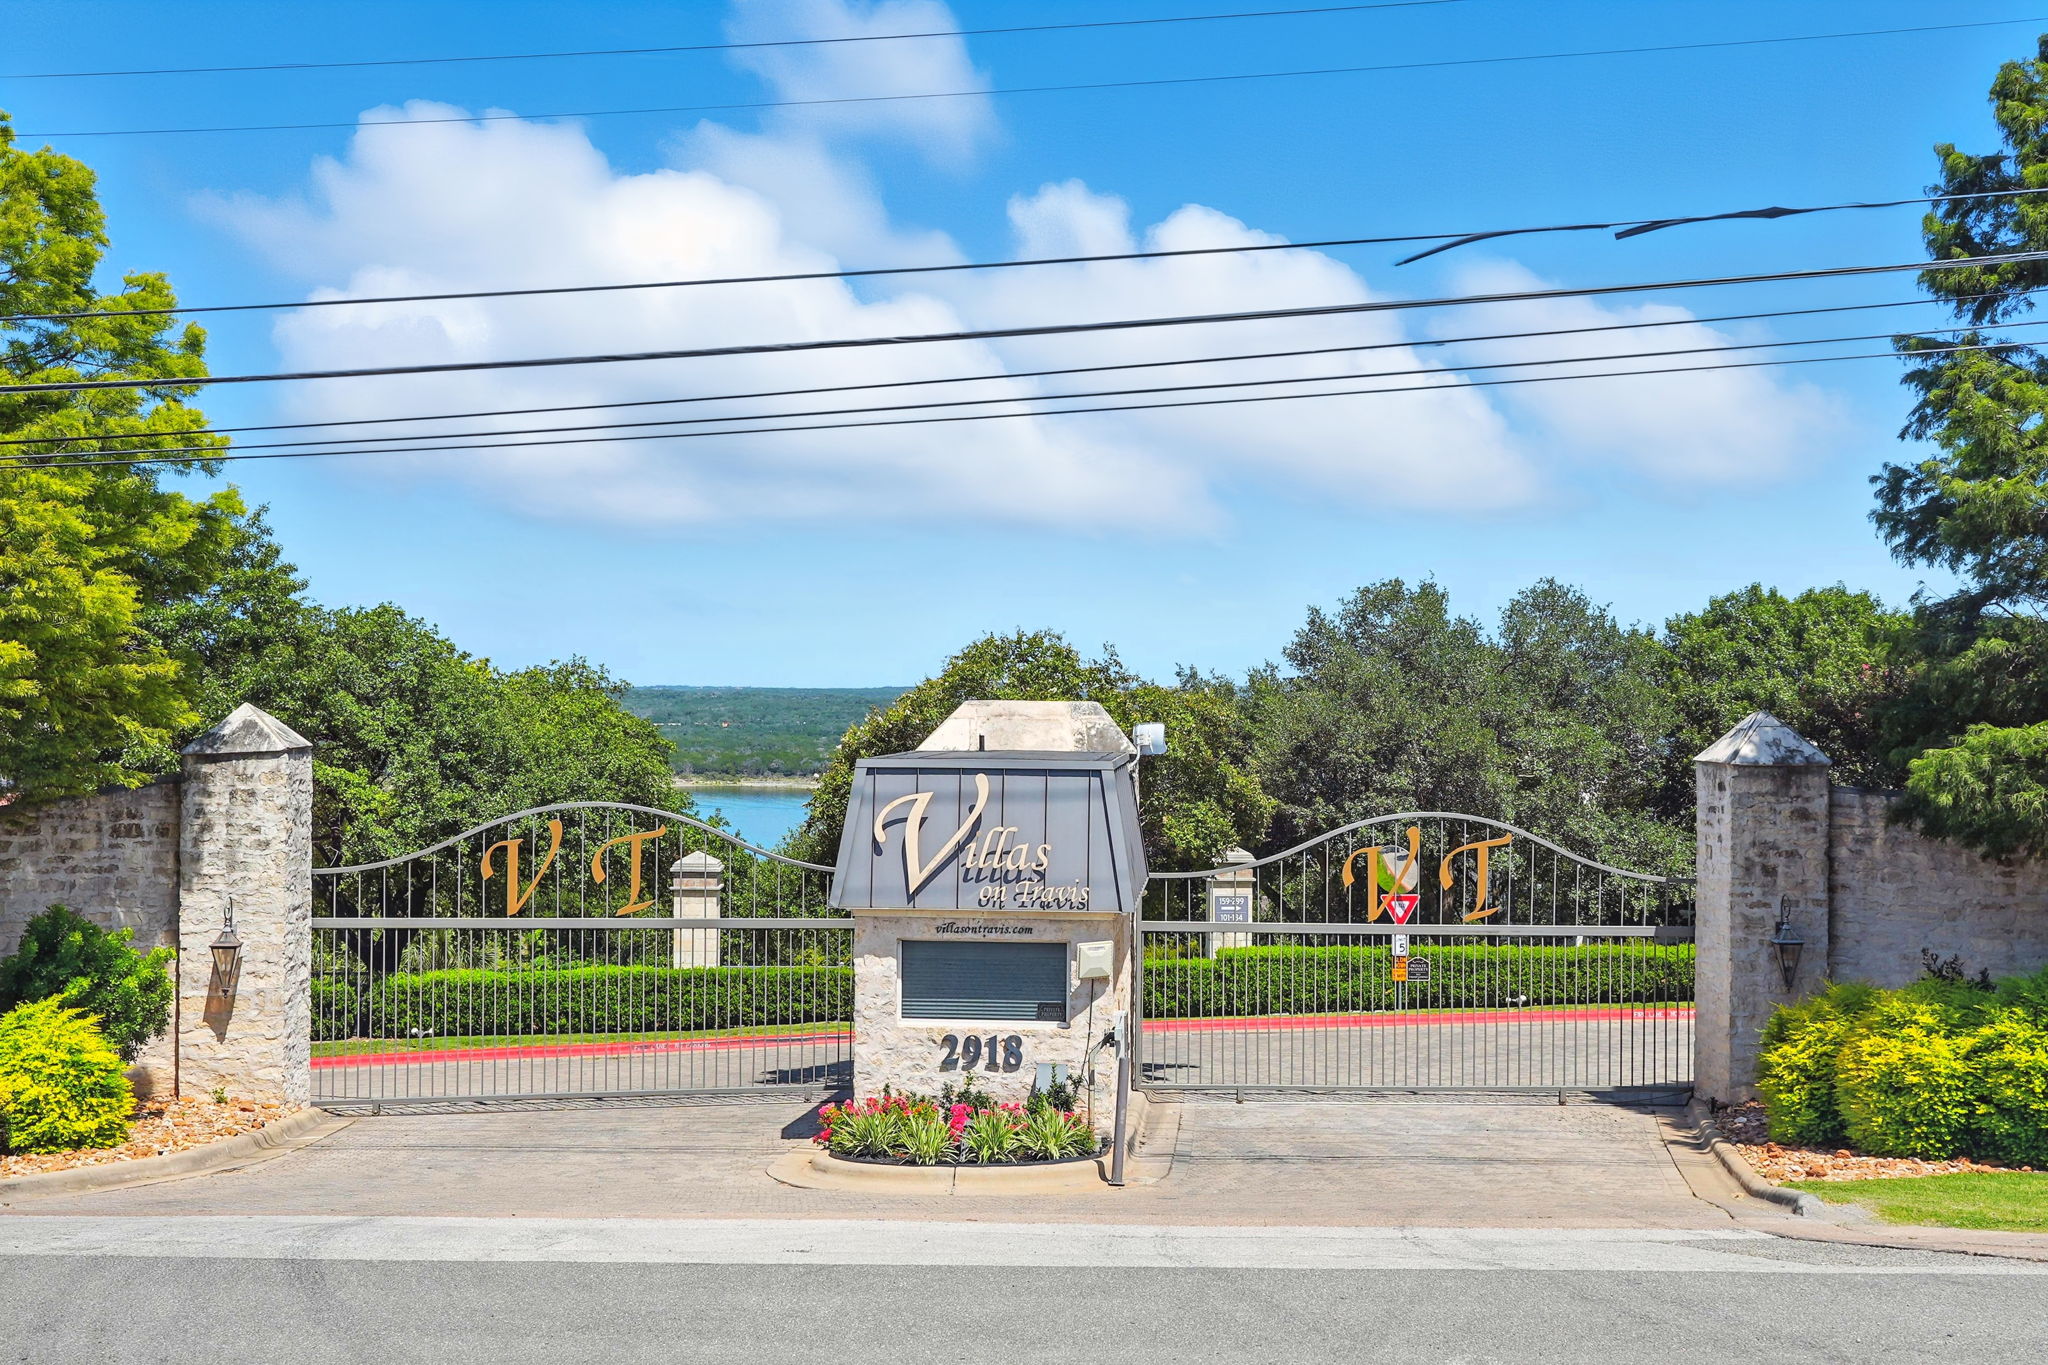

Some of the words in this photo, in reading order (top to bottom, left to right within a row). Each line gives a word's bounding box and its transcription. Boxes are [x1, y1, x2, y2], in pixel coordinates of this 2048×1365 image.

[874, 773, 1052, 895] Villas
[978, 884, 1008, 902] on
[1015, 878, 1090, 903] Travis
[935, 920, 1034, 935] villasontravis.com
[939, 1033, 1024, 1071] 2918
